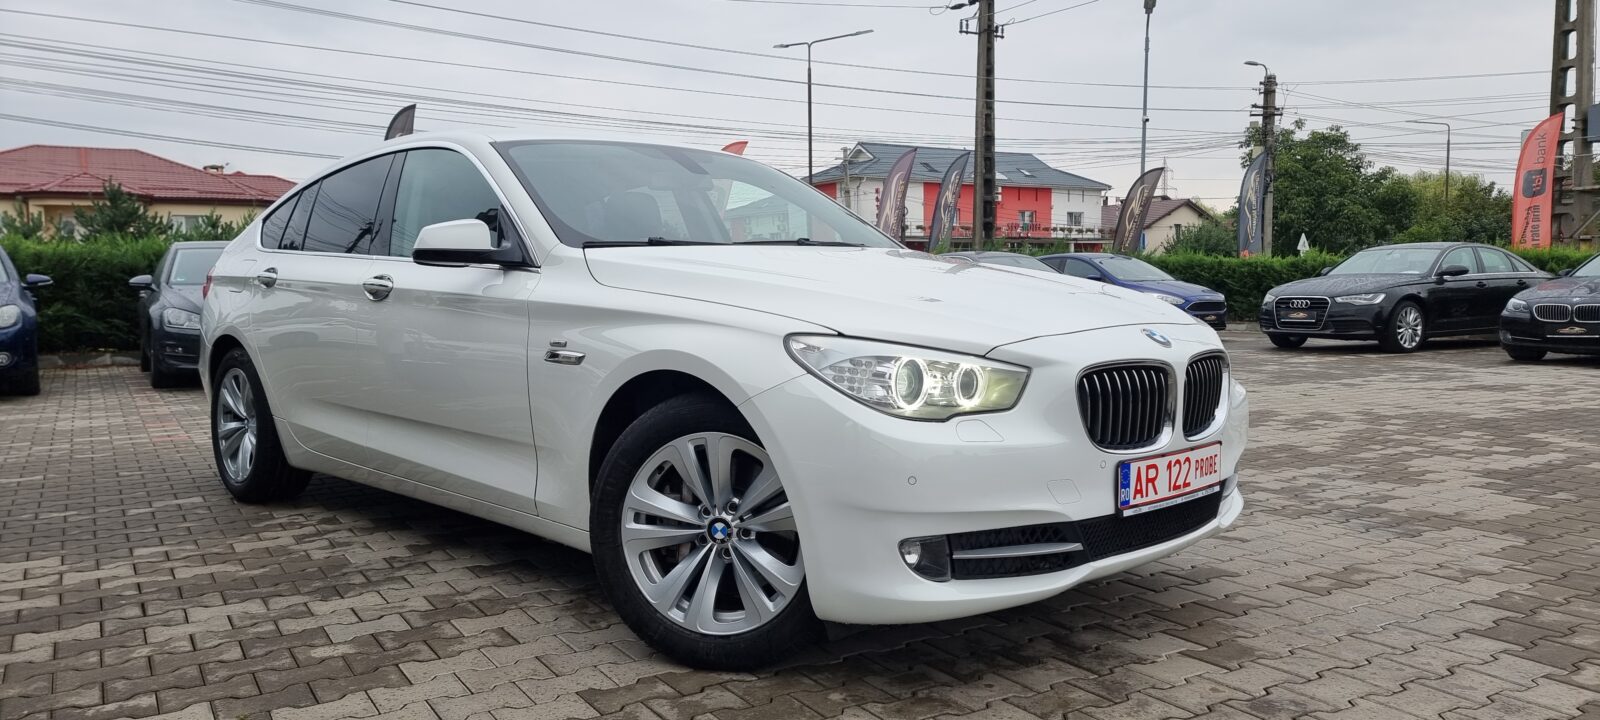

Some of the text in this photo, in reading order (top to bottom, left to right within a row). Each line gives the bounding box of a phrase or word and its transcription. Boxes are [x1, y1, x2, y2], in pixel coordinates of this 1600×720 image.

[1534, 132, 1547, 165] bank
[1530, 224, 1540, 242] rate
[1132, 463, 1159, 500] AR
[1166, 456, 1192, 493] 122
[1194, 454, 1218, 480] PROBE
[1120, 488, 1130, 502] RO
